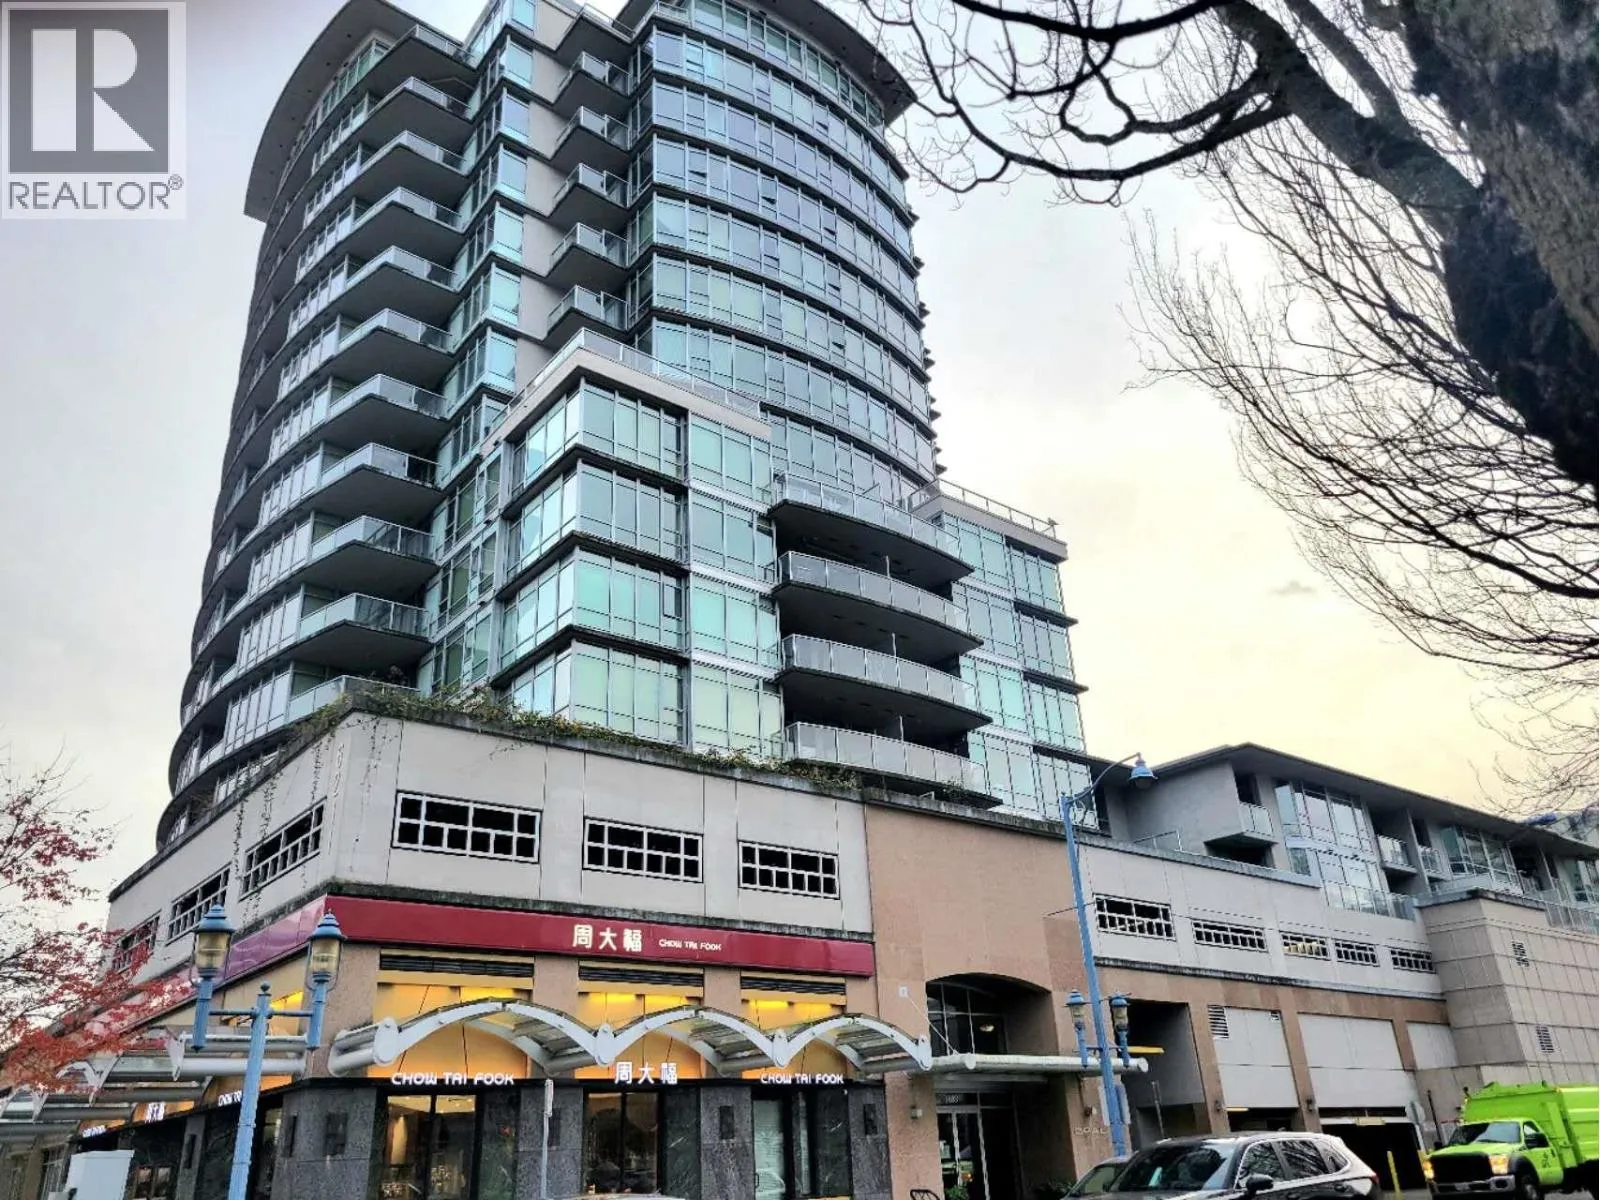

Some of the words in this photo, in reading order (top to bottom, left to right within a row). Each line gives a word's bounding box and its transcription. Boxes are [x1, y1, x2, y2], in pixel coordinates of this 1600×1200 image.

[572, 923, 642, 952] 周大福
[658, 938, 682, 949] CHOW
[684, 941, 698, 949] TAI
[700, 942, 722, 951] FOOK
[391, 1072, 438, 1085] CHOW
[443, 1072, 467, 1085] TAI
[474, 1072, 515, 1085] FOOK
[614, 1061, 678, 1084] 周大福
[760, 1073, 792, 1084] CHOW
[795, 1073, 811, 1084] TAI
[815, 1073, 844, 1084] FOOK
